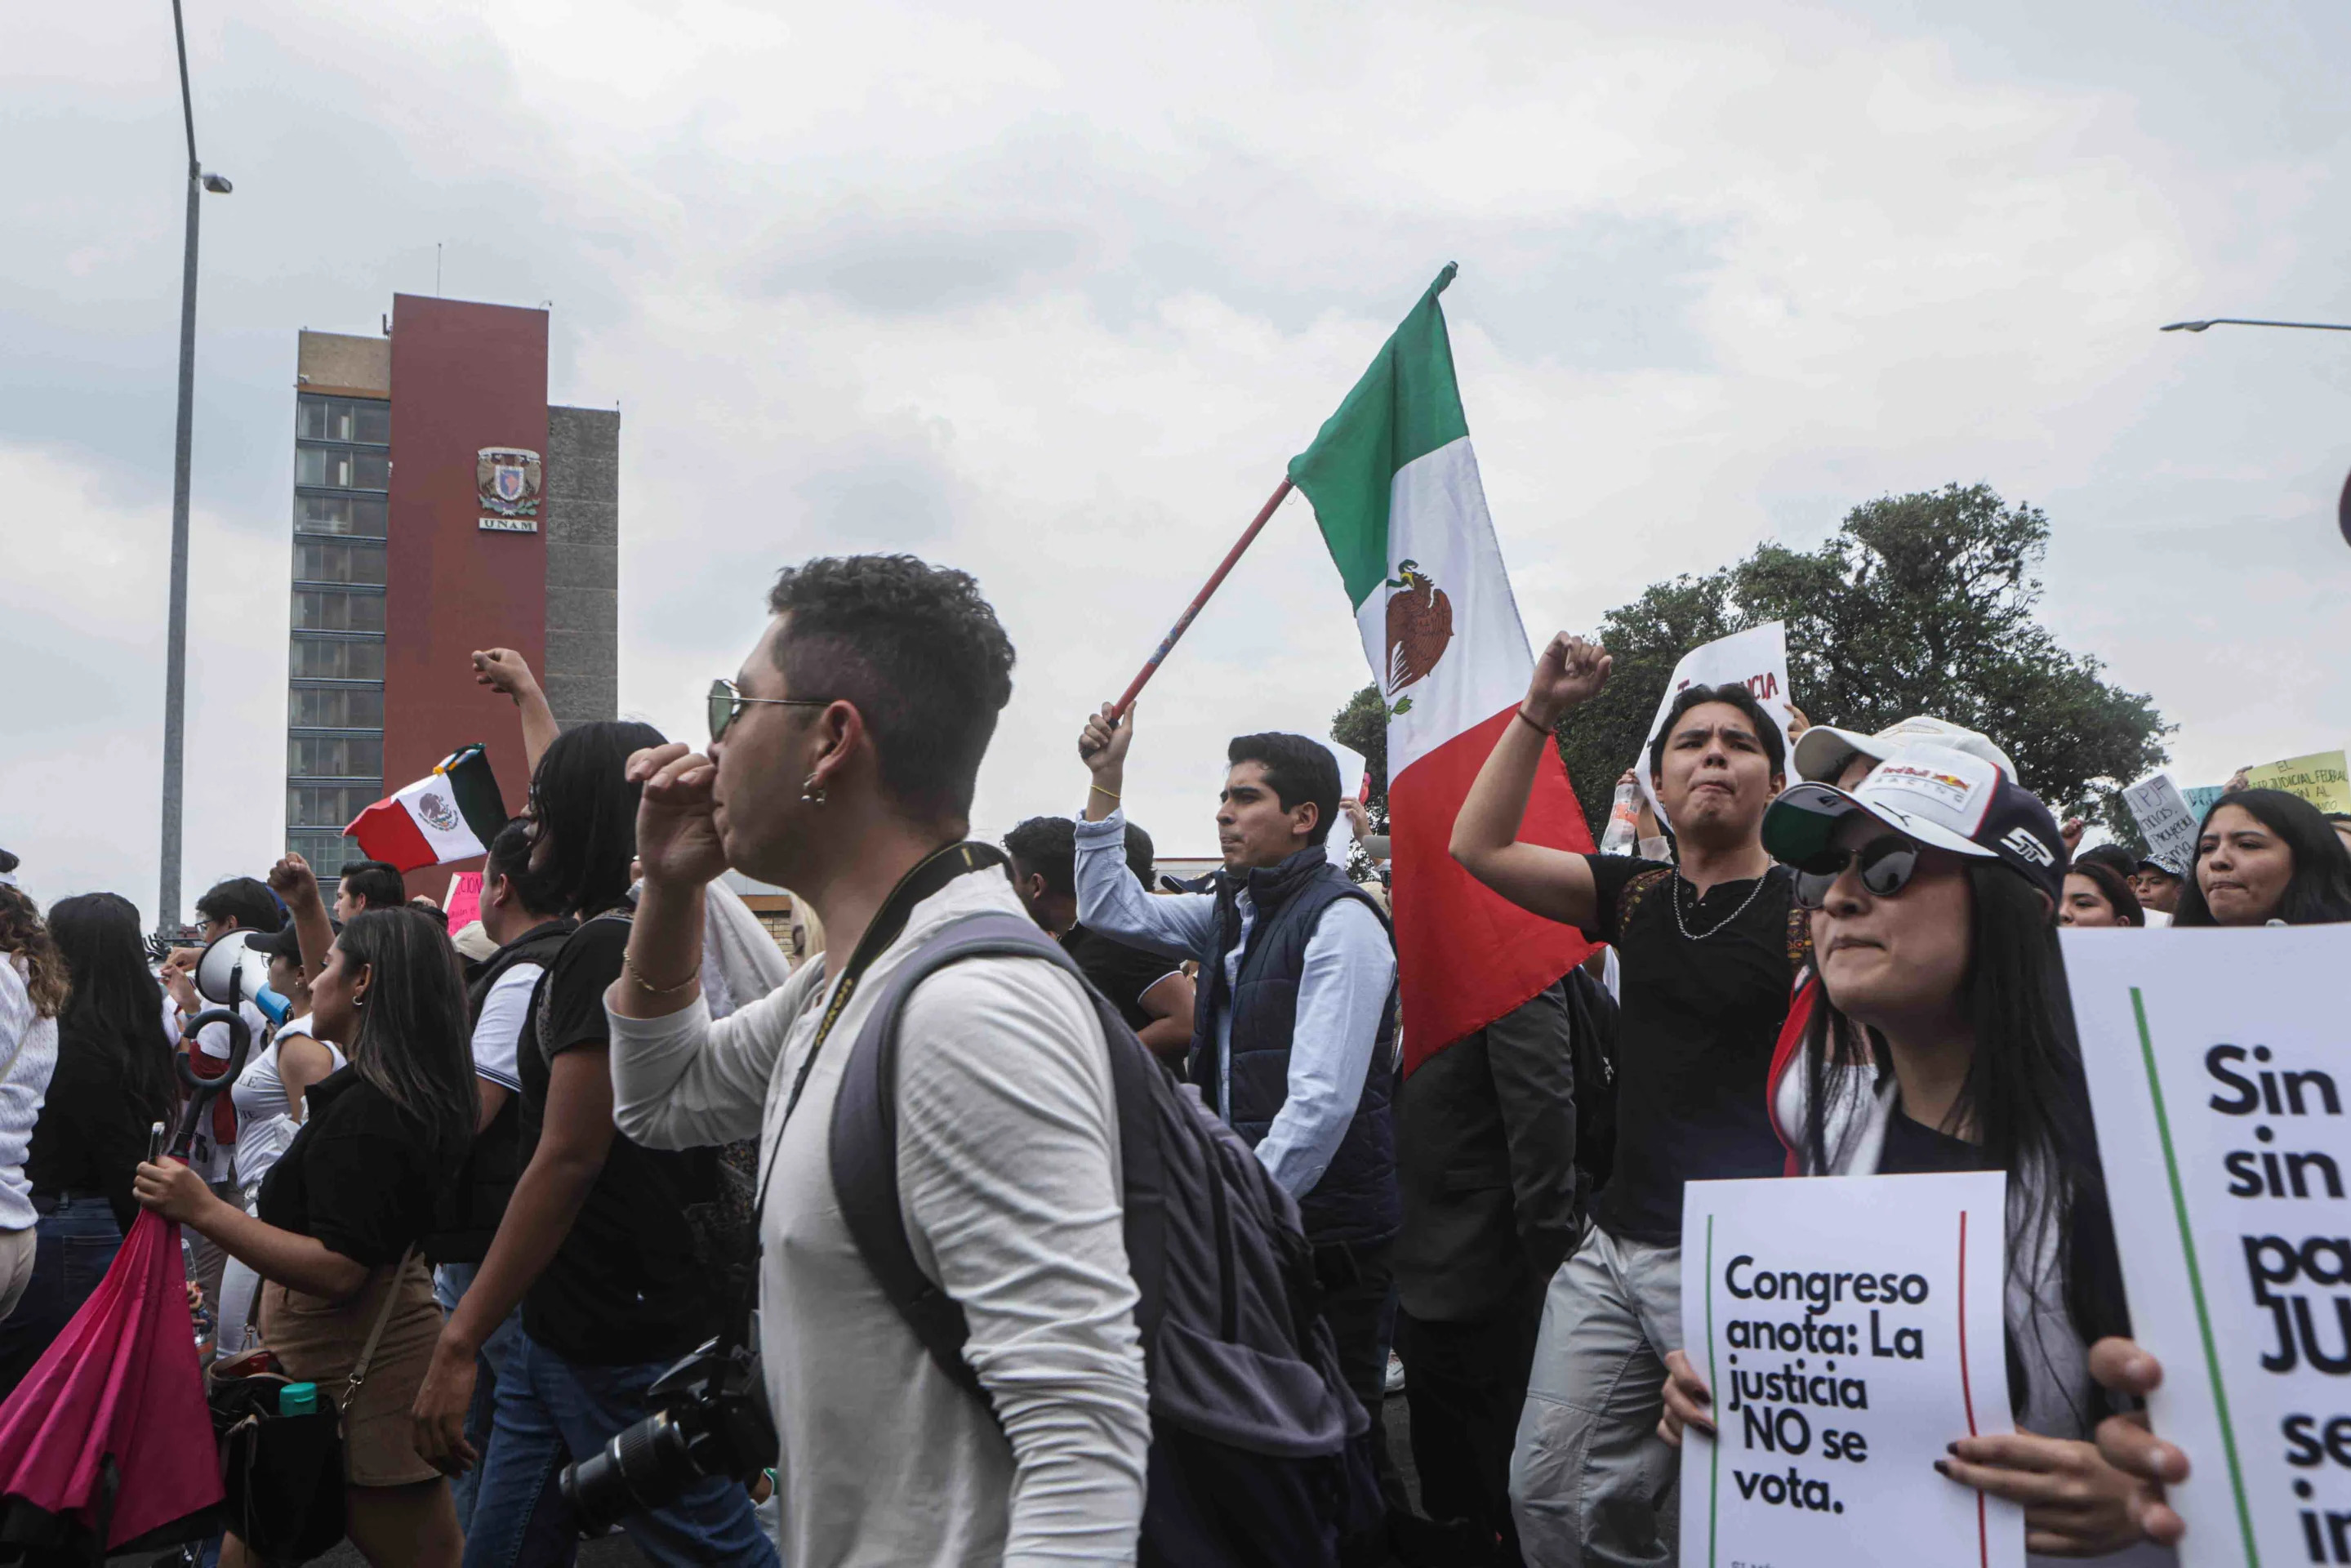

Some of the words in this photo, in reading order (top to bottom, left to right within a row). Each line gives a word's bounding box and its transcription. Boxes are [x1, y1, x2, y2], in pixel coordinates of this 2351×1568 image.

[484, 519, 532, 530] UNAM
[2205, 1044, 2342, 1116] Sin
[2224, 1125, 2346, 1199] sin
[1725, 1254, 1929, 1316] Congreso
[1726, 1313, 1859, 1356] anota:
[1870, 1309, 1924, 1360] La
[1728, 1353, 1868, 1412] justicia
[1743, 1404, 1811, 1455] NO
[1822, 1428, 1868, 1463] se
[1732, 1467, 1844, 1515] vota.
